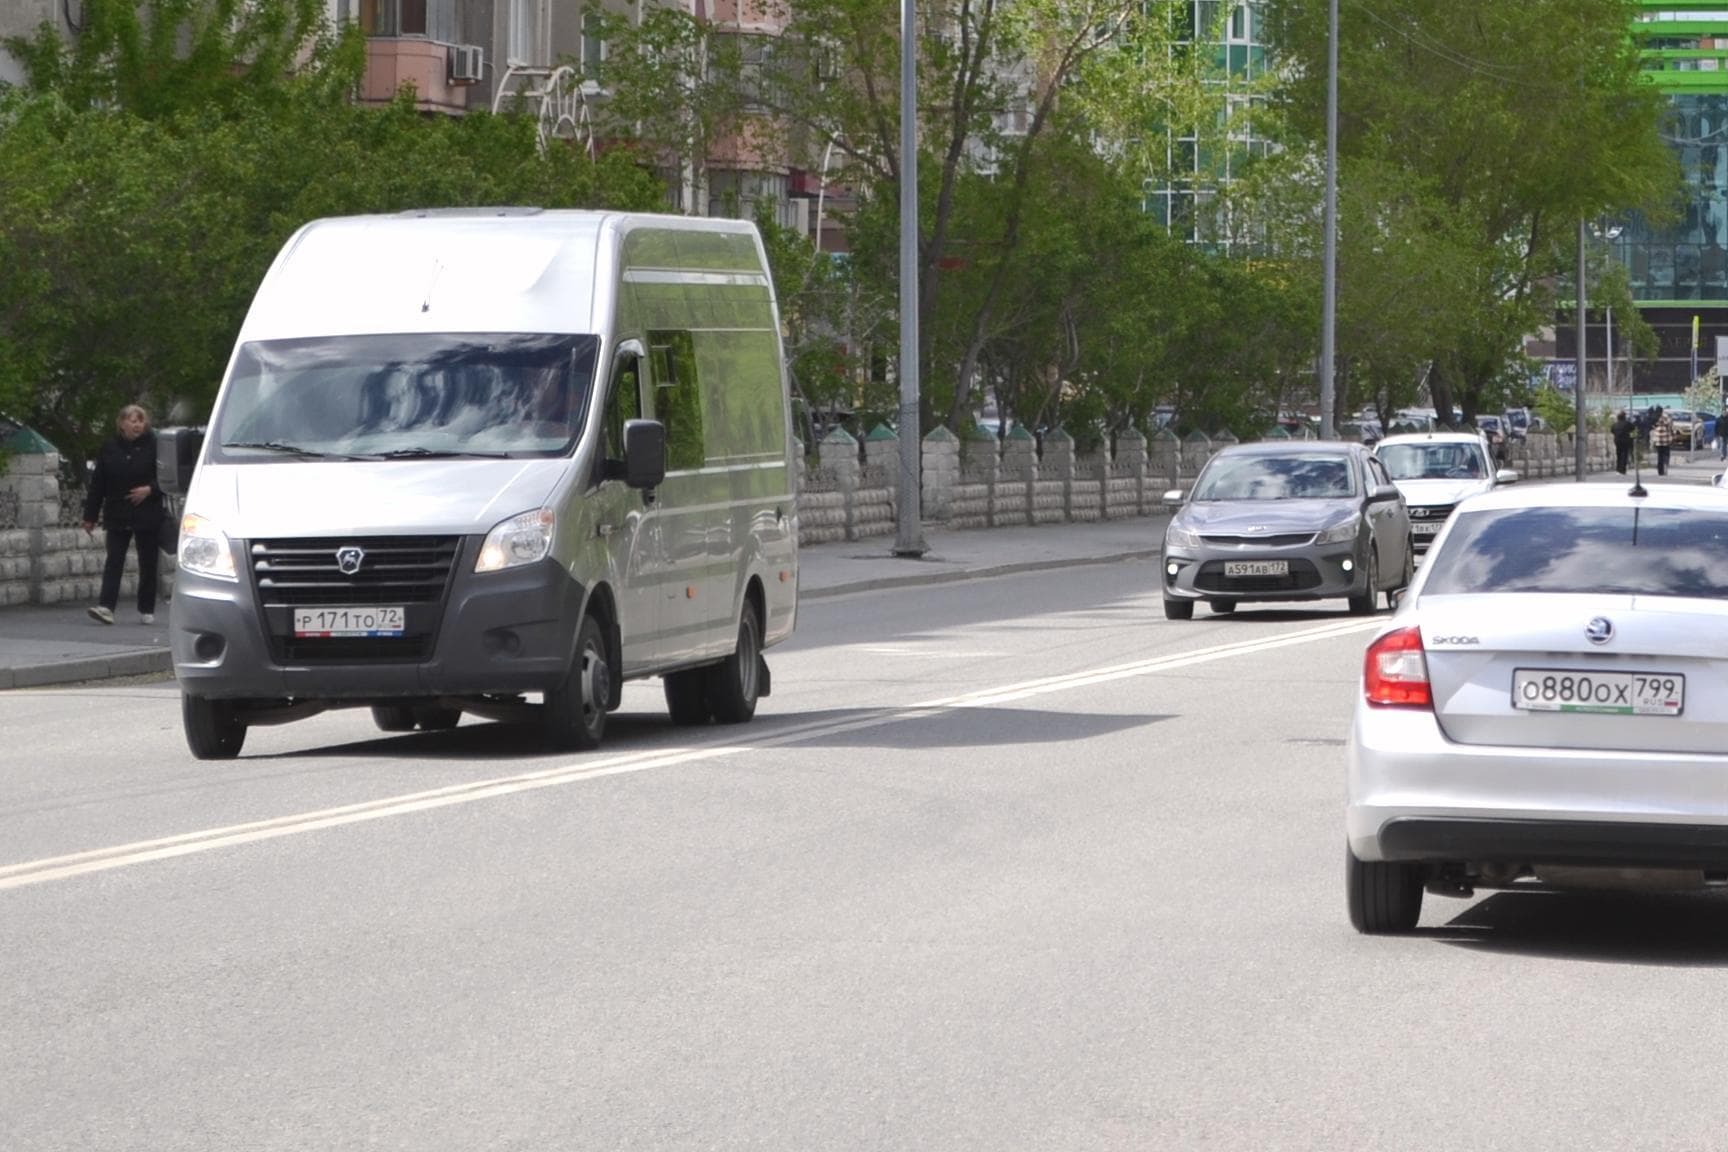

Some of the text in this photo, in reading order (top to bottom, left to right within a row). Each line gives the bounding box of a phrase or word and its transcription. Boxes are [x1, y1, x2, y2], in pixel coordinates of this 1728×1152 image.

[301, 609, 398, 629] Р171ТО 72
[1635, 677, 1675, 698] 799
